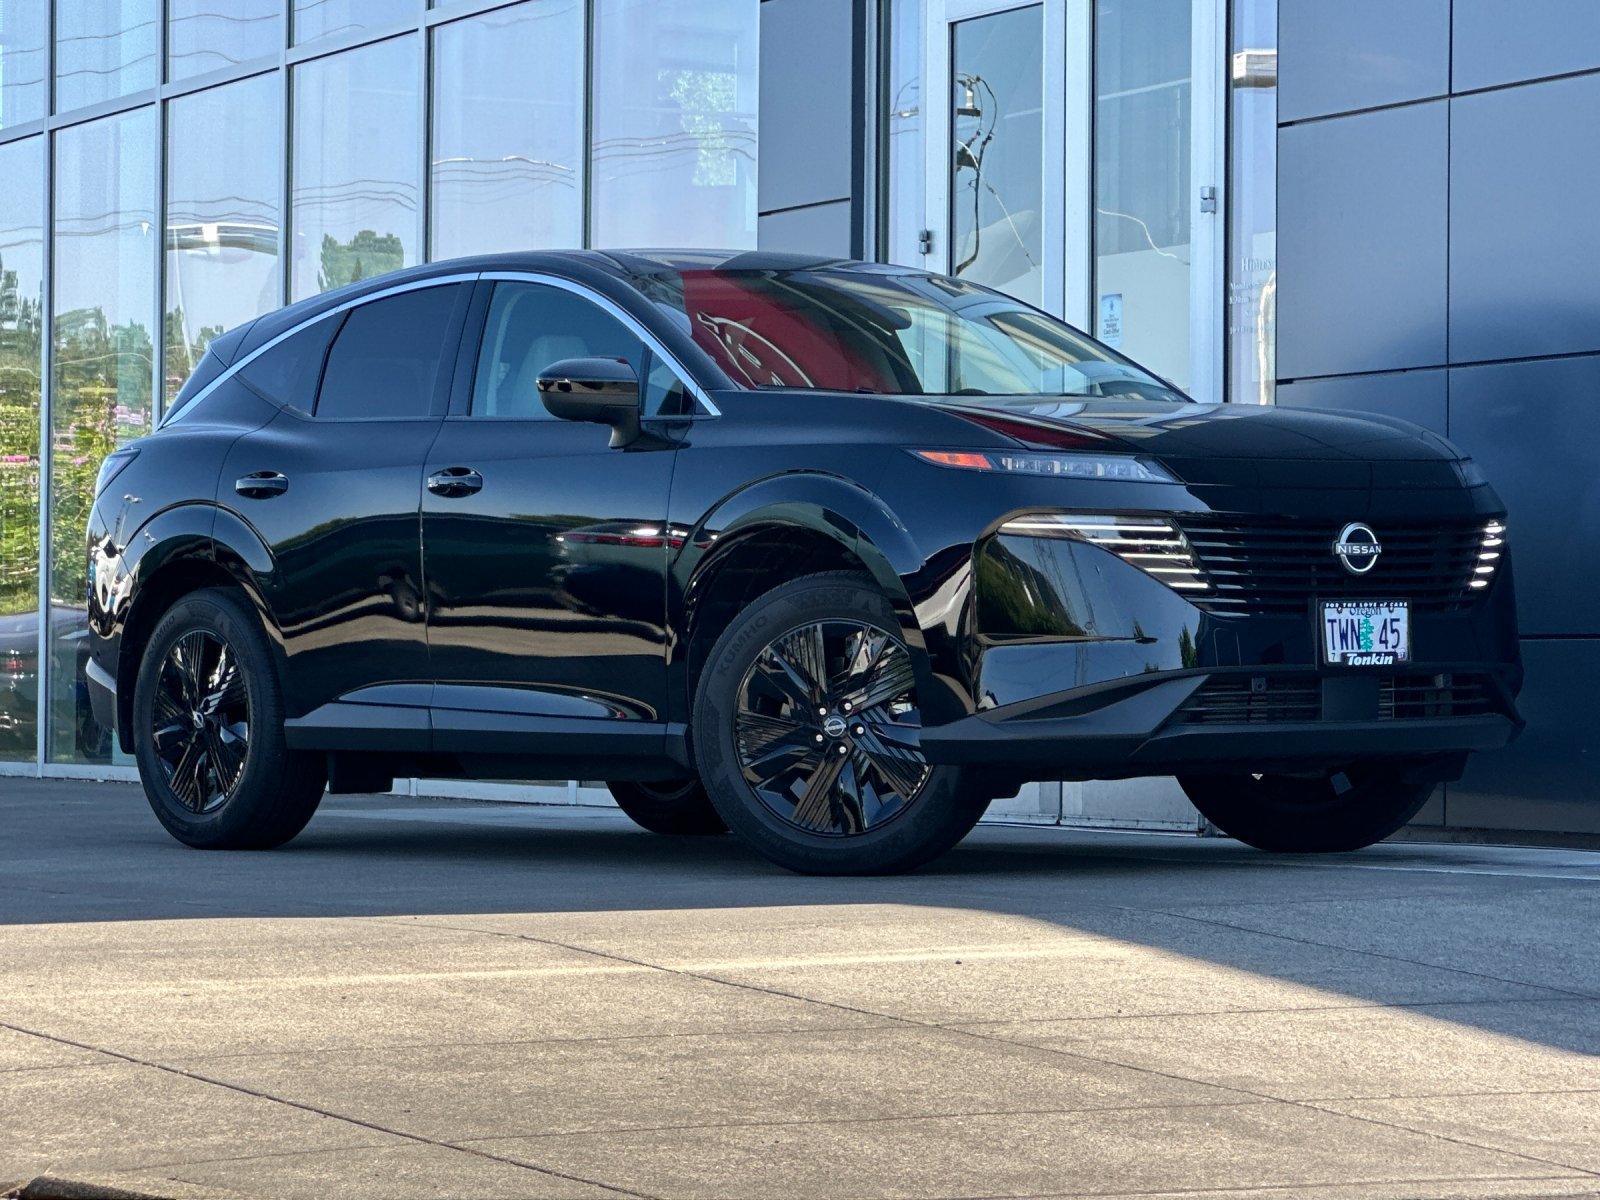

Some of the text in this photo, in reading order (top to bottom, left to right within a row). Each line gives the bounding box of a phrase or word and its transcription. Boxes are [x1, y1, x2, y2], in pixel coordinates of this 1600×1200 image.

[1337, 545, 1382, 554] NISSAN
[1350, 607, 1381, 617] Oregon
[1327, 618, 1400, 650] TWN 45
[716, 615, 768, 677] KUMHO
[1347, 653, 1393, 665] Tonkin
